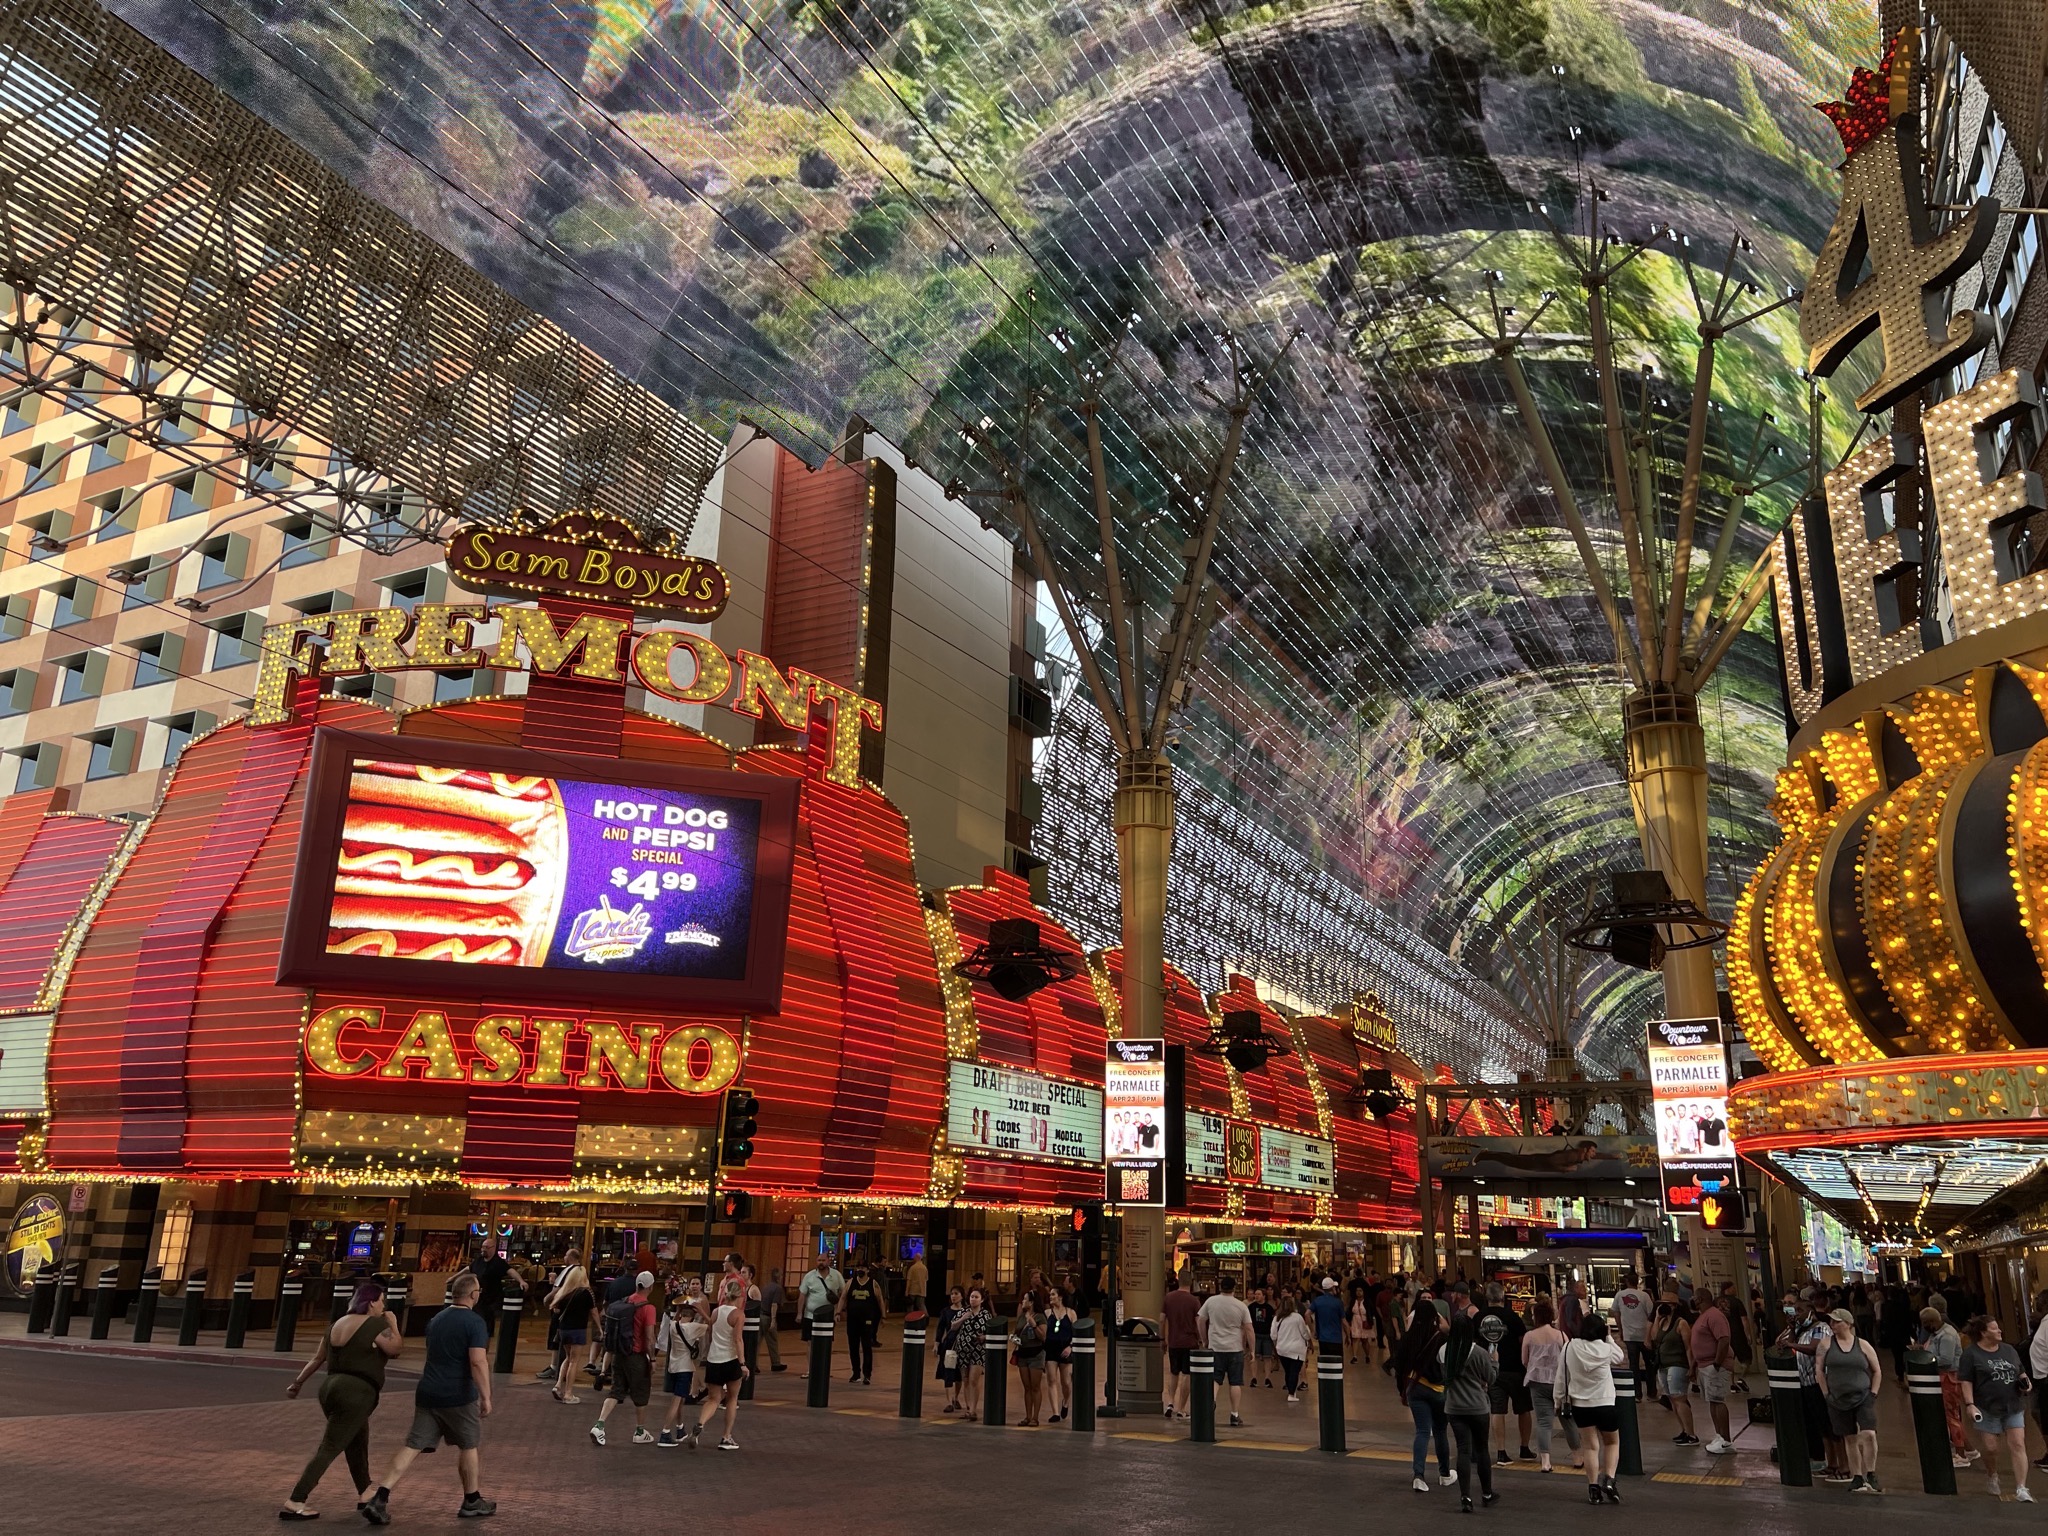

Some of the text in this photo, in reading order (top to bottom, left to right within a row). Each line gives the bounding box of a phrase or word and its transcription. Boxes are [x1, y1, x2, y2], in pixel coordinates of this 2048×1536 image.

[463, 533, 714, 600] Sam Boyd's
[245, 602, 885, 790] FREMONT
[594, 799, 728, 829] HOT DOG
[603, 826, 715, 851] AND PEPSI
[631, 848, 684, 865] SPECIAL
[665, 929, 721, 947] FREMONT
[1354, 1006, 1395, 1045] Sam Boyd's
[1659, 1023, 1708, 1035] Downtown
[304, 1004, 743, 1095] CASINO
[1116, 1041, 1154, 1052] Downtown
[1677, 1054, 1719, 1062] CONCERT
[1656, 1066, 1721, 1081] PARMALEE
[973, 1067, 1087, 1108] DRAFT BEER SPECIAL
[1110, 1080, 1160, 1091] PARMALEE
[1032, 1102, 1051, 1115] BEER
[972, 1106, 990, 1144] $8
[996, 1120, 1021, 1134] COORS
[1030, 1116, 1048, 1152] $9
[1055, 1129, 1083, 1143] MODELO
[1232, 1127, 1254, 1149] LOOSE
[996, 1136, 1020, 1150] LIGHT
[1052, 1144, 1087, 1158] ESPECIAL
[1204, 1141, 1219, 1152] STEAK
[1233, 1157, 1255, 1177] SLOTS
[20, 1228, 33, 1239] STILL
[40, 1220, 56, 1231] CENTS
[1212, 1241, 1246, 1255] CIGARS
